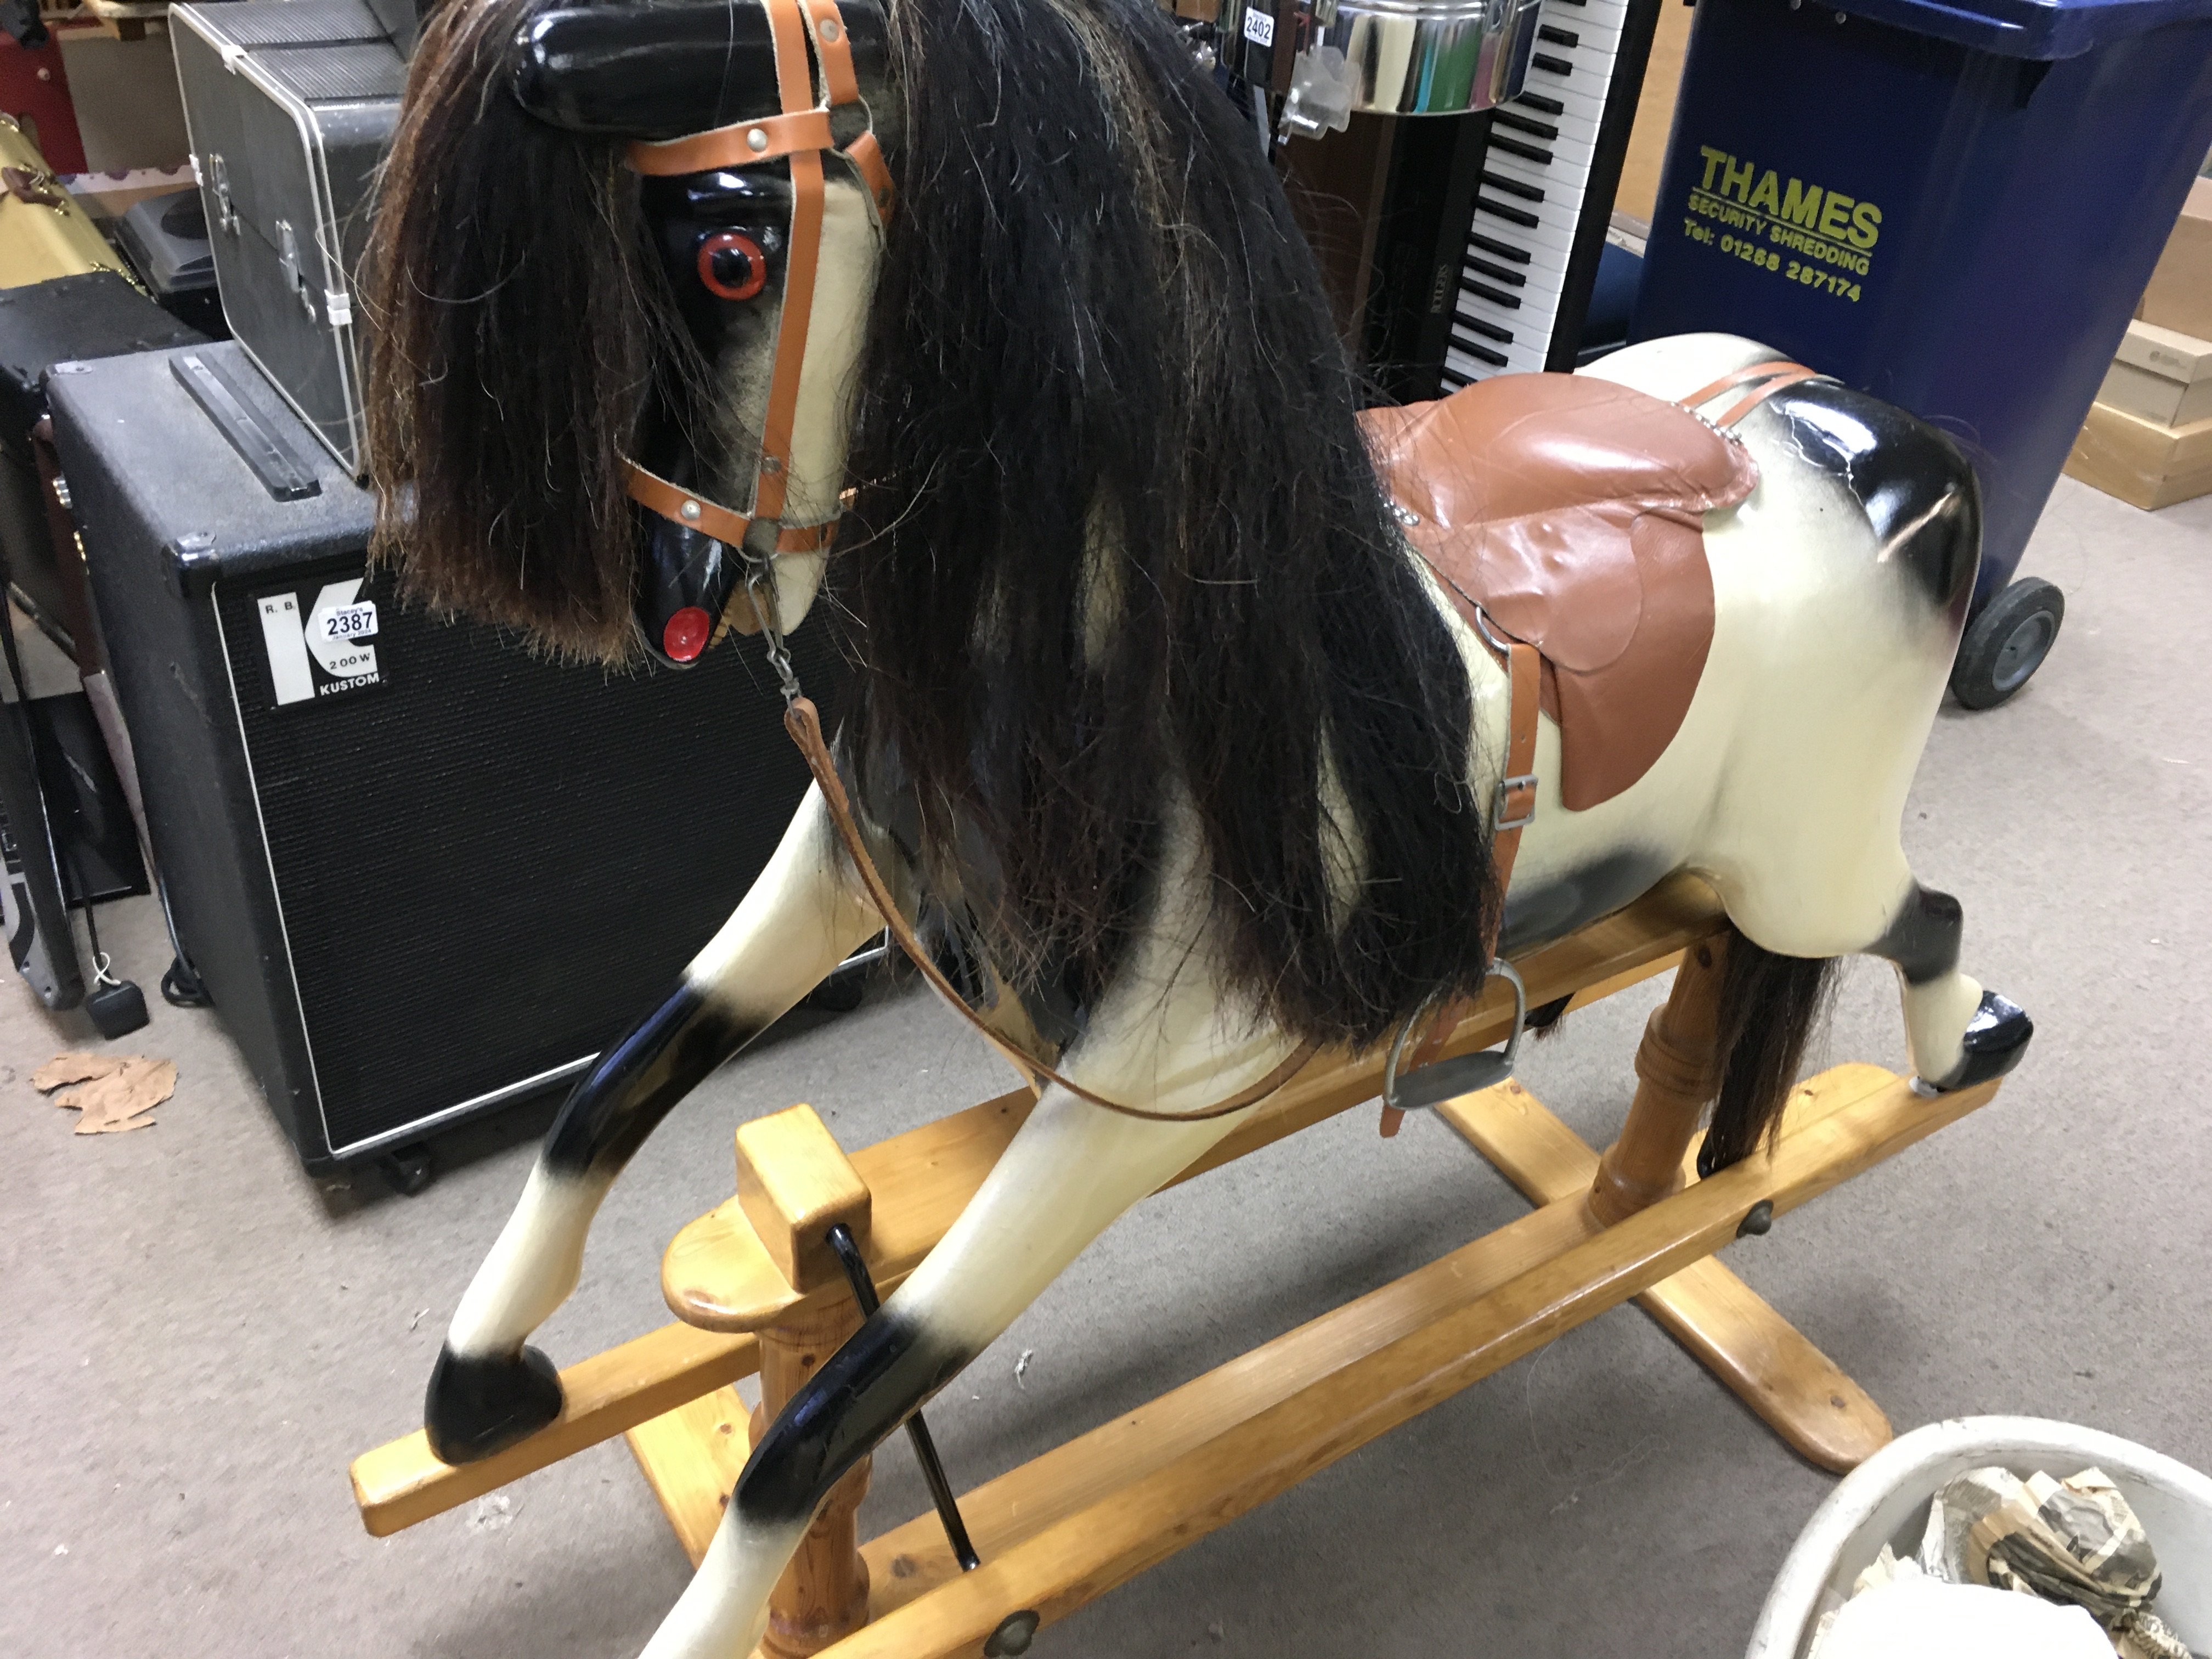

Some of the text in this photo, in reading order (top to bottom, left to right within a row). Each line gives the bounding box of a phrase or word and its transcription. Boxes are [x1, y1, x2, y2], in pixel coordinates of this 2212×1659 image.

[1246, 15, 1271, 40] 2402
[1700, 145, 1882, 249] THAMES
[1688, 193, 1870, 276] SECURITY SHREDDING
[1684, 216, 1861, 302] Tel: 01268 287174
[326, 612, 373, 636] 2387
[336, 607, 363, 616] Stacey's
[319, 672, 380, 696] KUSTOM
